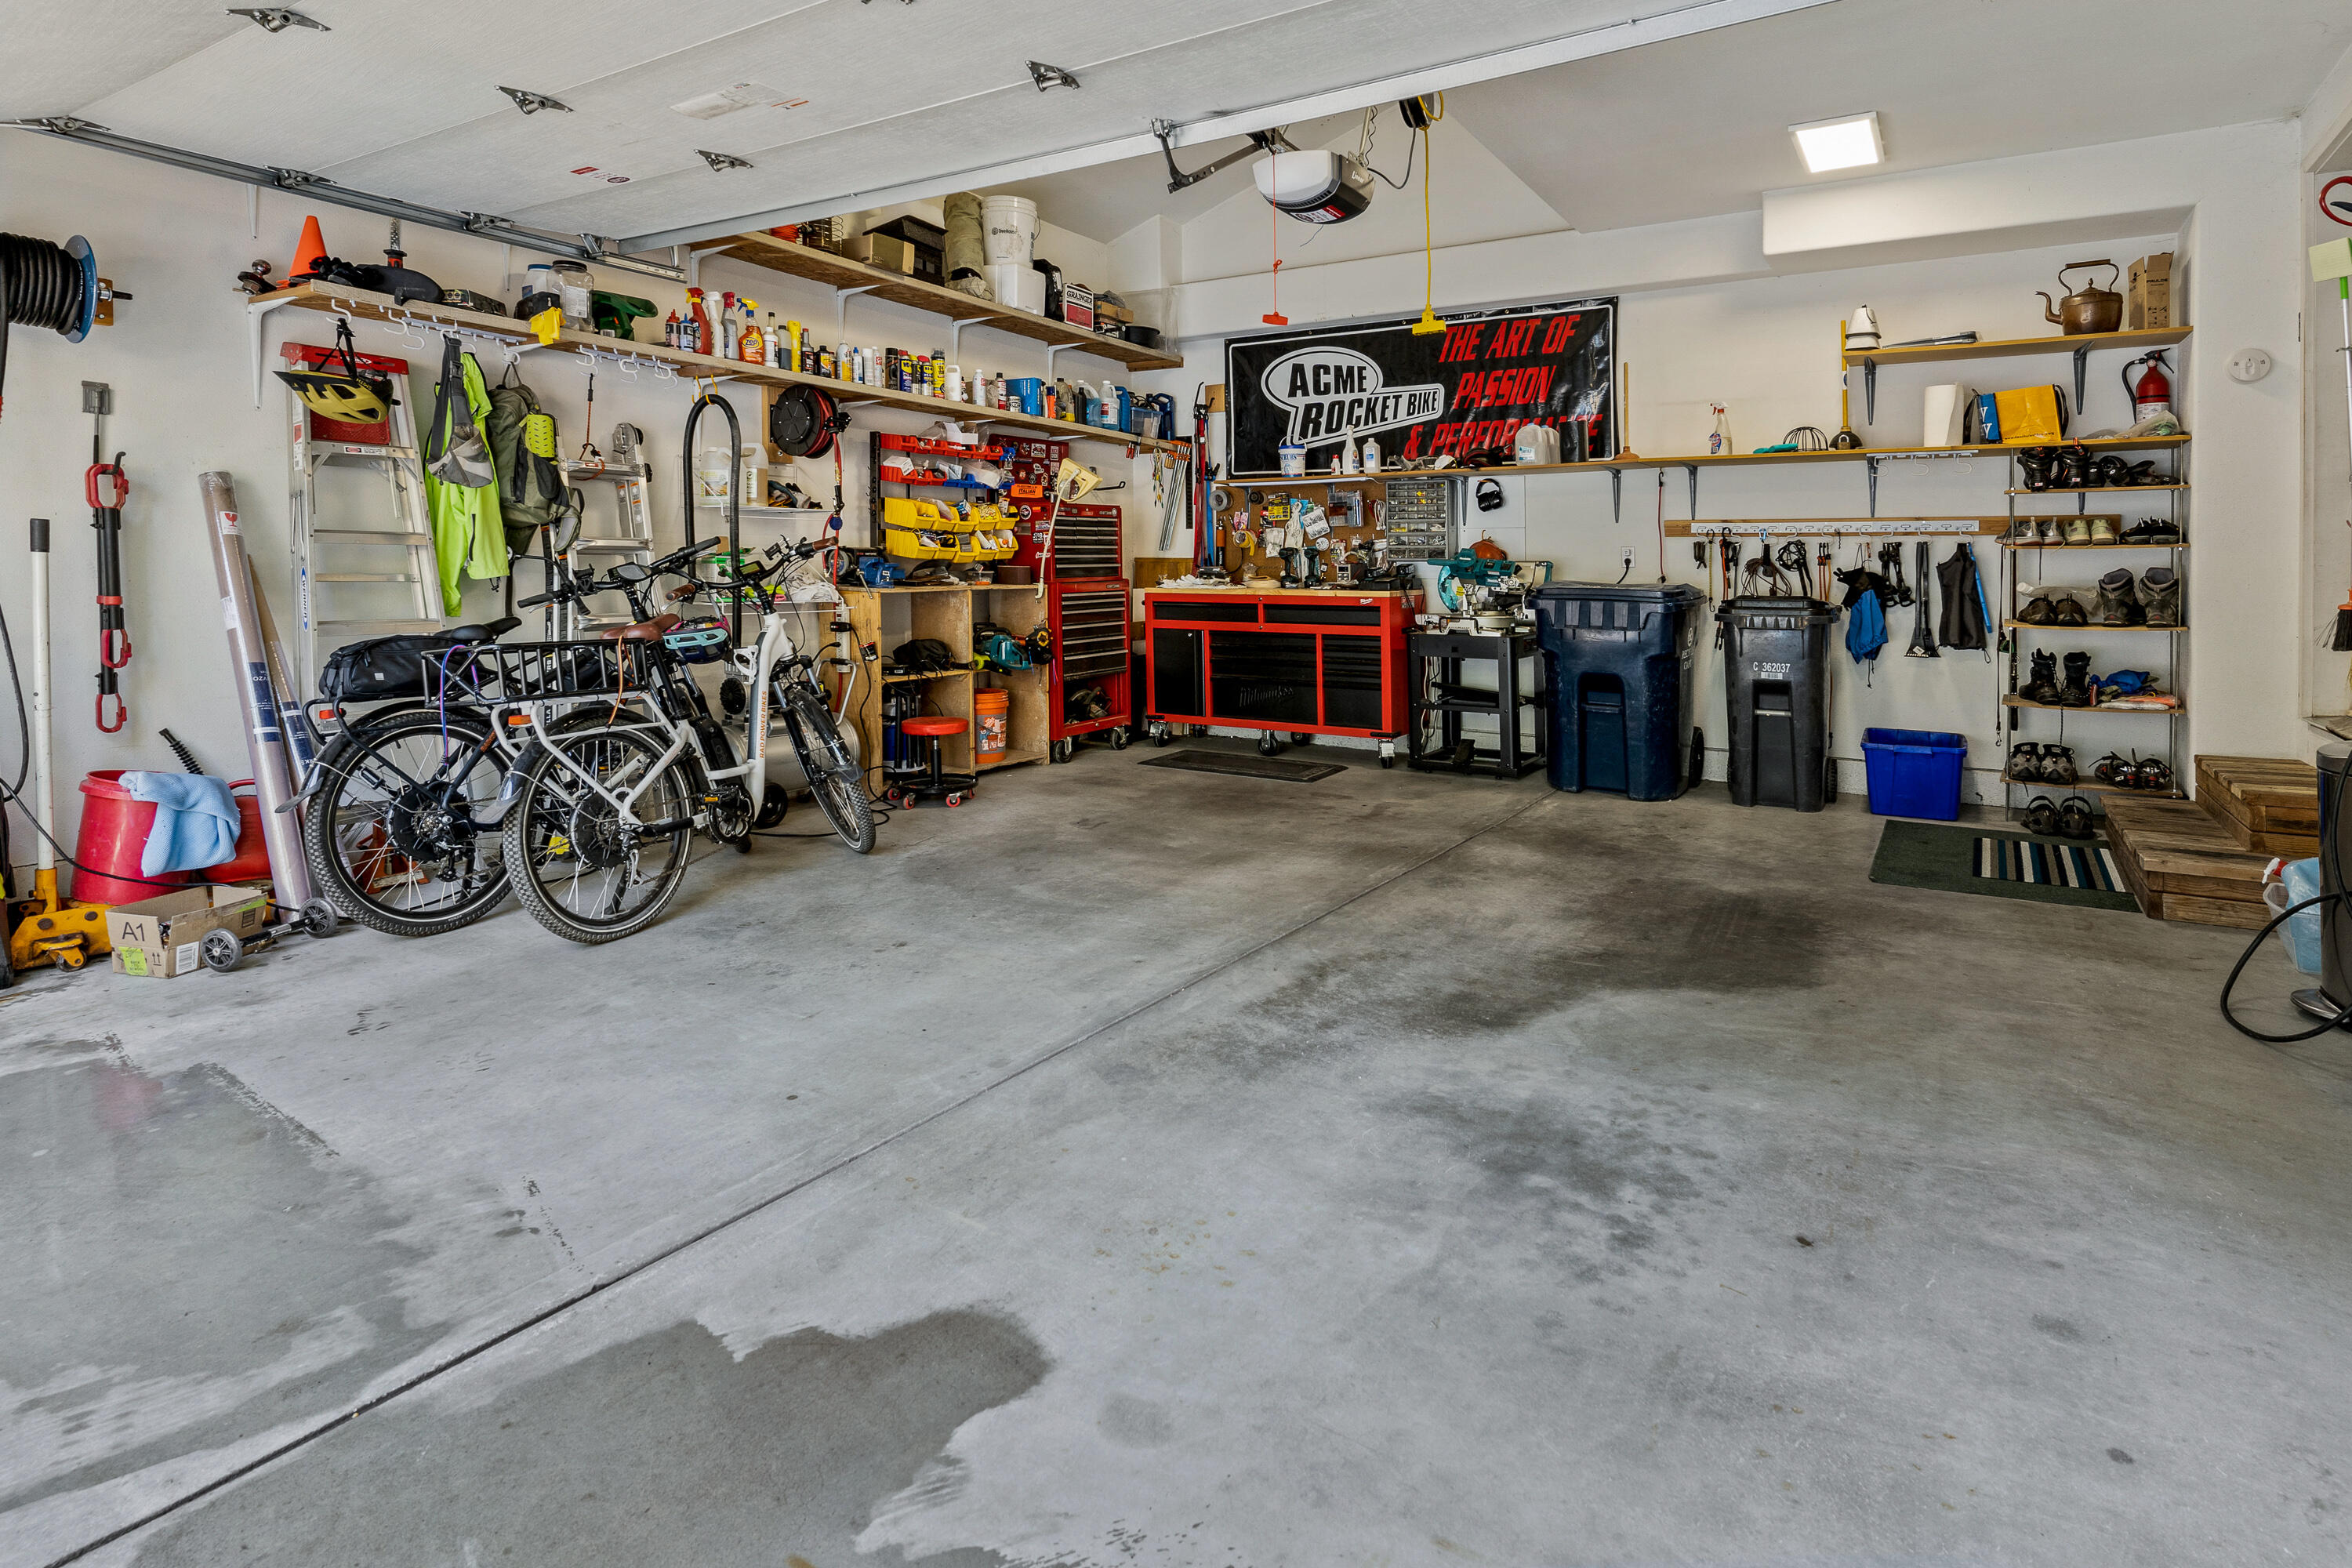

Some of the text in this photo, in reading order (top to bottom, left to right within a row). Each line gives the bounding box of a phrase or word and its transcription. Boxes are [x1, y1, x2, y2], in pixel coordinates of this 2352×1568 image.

[1066, 290, 1093, 304] GRAINGER
[1439, 314, 1581, 363] THE ART OF
[1287, 363, 1367, 398] ACME
[1453, 365, 1557, 409] PASSION
[1298, 390, 1438, 442] ROCKET BIKE
[1403, 424, 1425, 461] &
[1753, 662, 1791, 673] C 362037
[122, 921, 145, 942] A1
